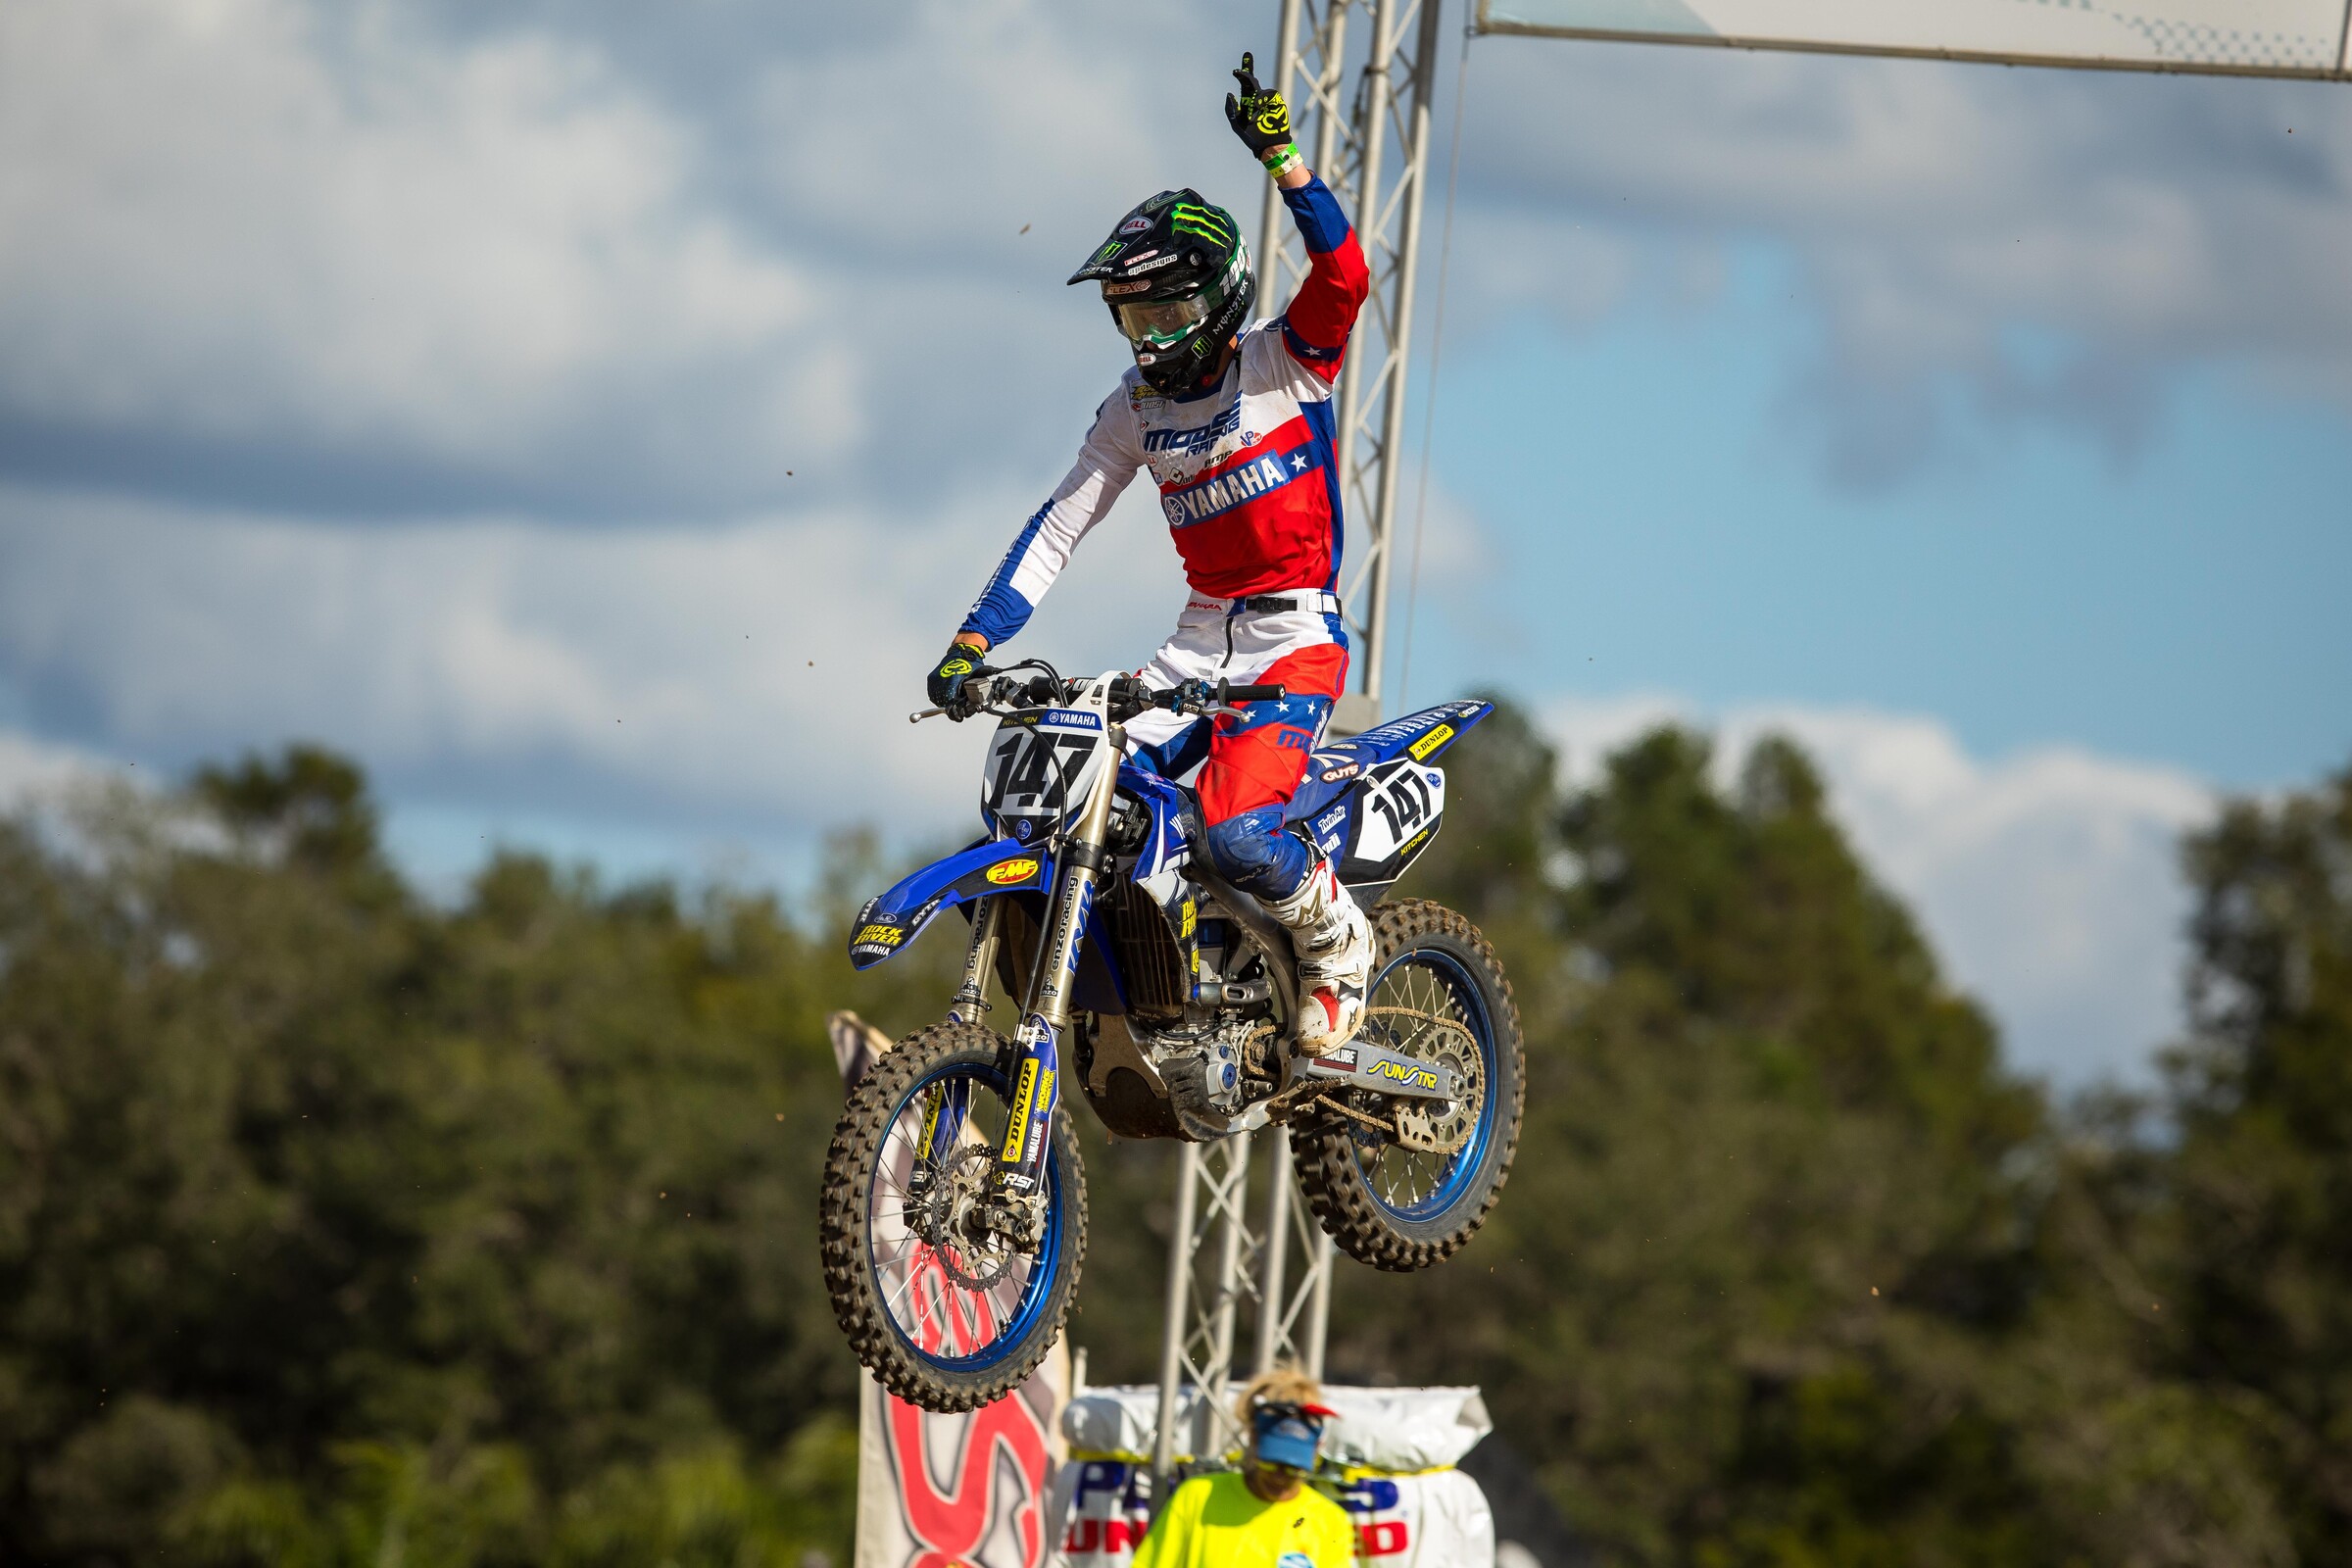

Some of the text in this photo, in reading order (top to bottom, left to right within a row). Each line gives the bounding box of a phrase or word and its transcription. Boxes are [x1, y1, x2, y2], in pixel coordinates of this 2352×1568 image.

[1124, 220, 1147, 230] BELL
[1128, 255, 1177, 275] apdesigns
[1240, 430, 1254, 447] VP
[1180, 457, 1285, 519] YAMAHA
[1059, 713, 1096, 727] YAMAHA
[1420, 726, 1448, 752] DUNLOP
[988, 732, 1099, 808] 147
[1323, 764, 1359, 781] GUTS
[1371, 768, 1432, 845] 147
[1400, 829, 1429, 856] KITCHEN
[989, 860, 1037, 882] FMF
[911, 899, 941, 926] GYTR
[854, 933, 902, 946] RIVER
[859, 925, 904, 937] ROCK
[858, 944, 891, 956] YAMAHA
[1010, 1062, 1032, 1142] DUNLOP
[1027, 1119, 1044, 1163] YAMALUBE
[1003, 1172, 1035, 1189] RST
